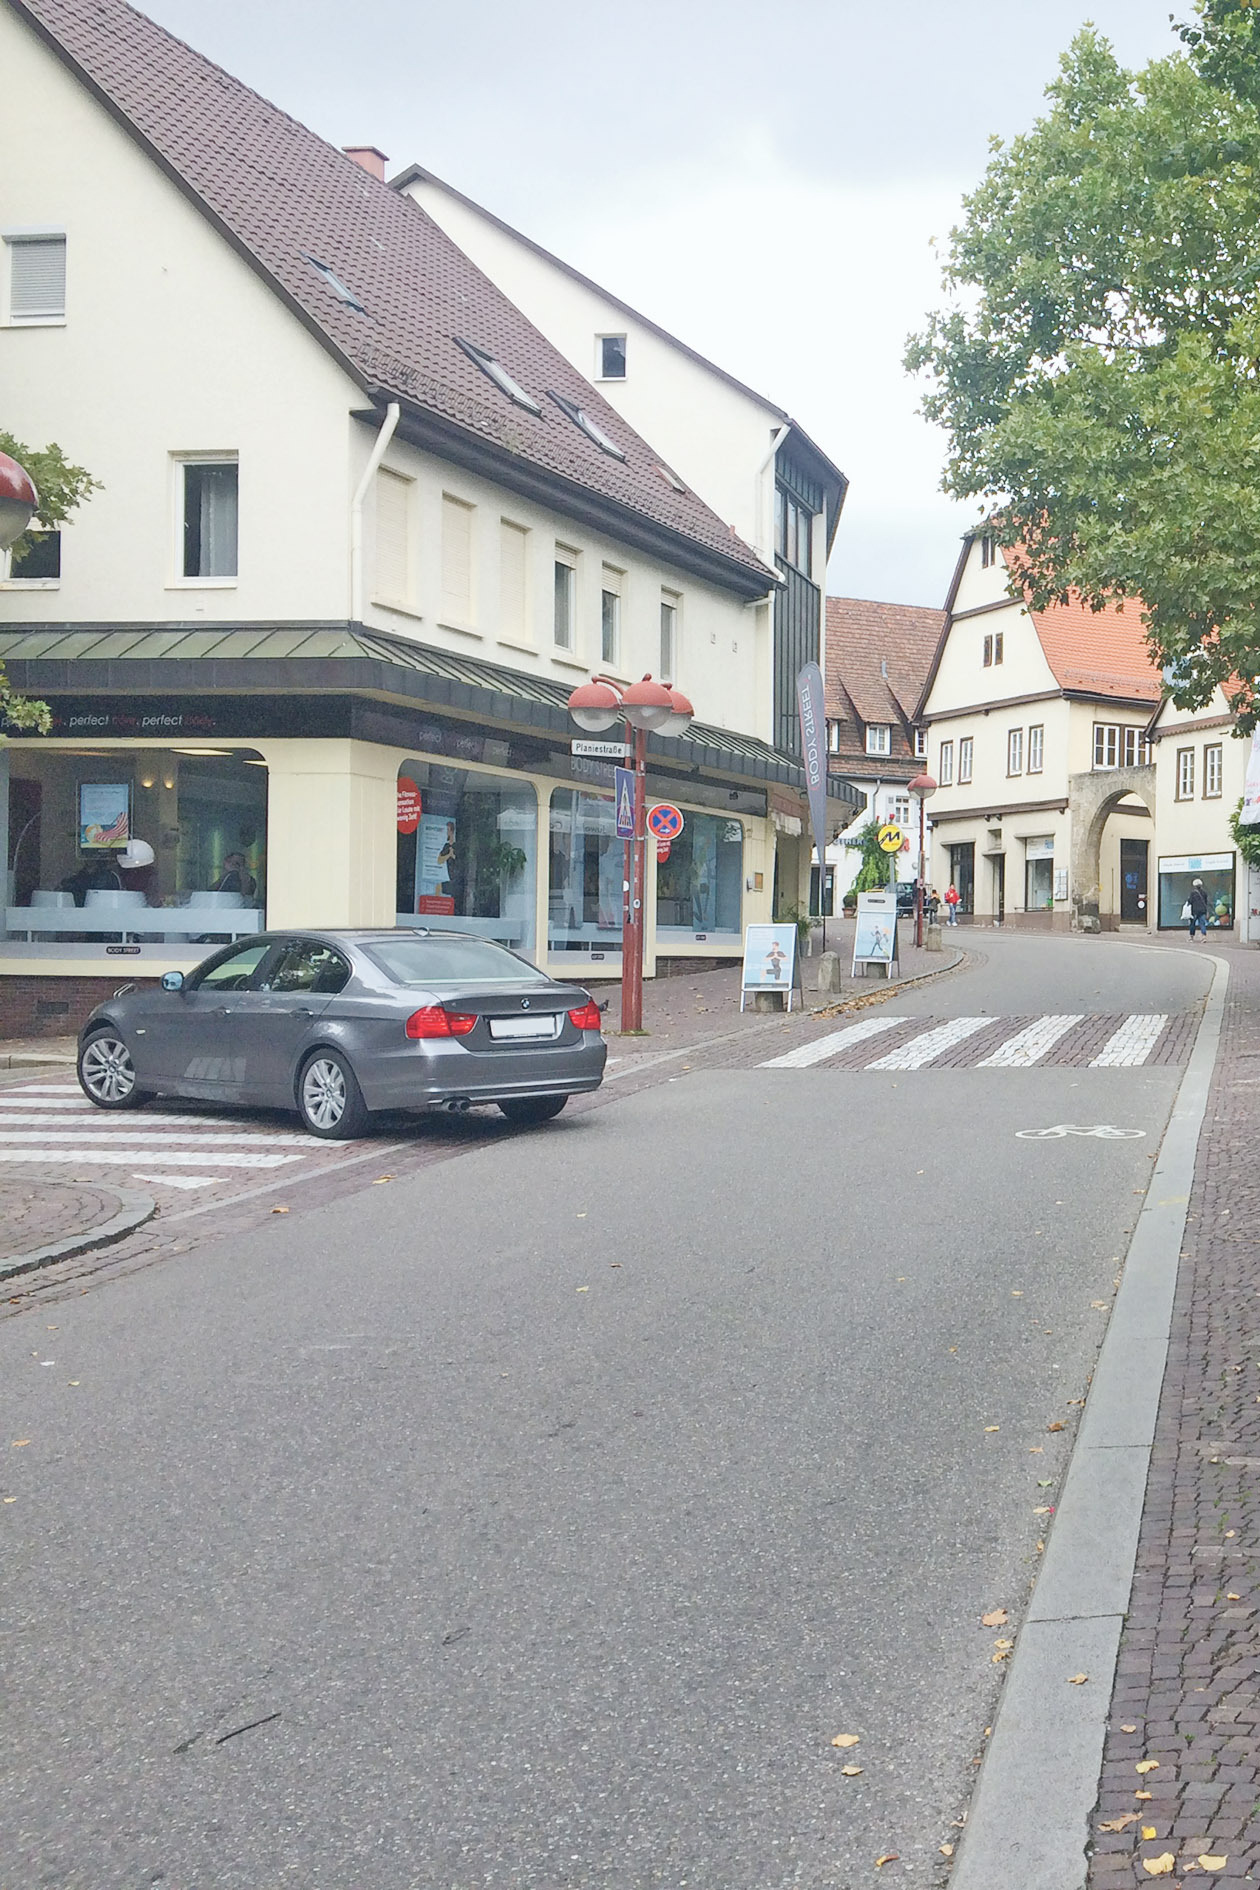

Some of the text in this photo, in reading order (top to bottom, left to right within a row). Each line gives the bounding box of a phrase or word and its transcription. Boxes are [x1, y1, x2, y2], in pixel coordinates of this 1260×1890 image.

[69, 715, 109, 727] perfect
[142, 715, 183, 727] perfect
[576, 743, 623, 755] Planiestraße
